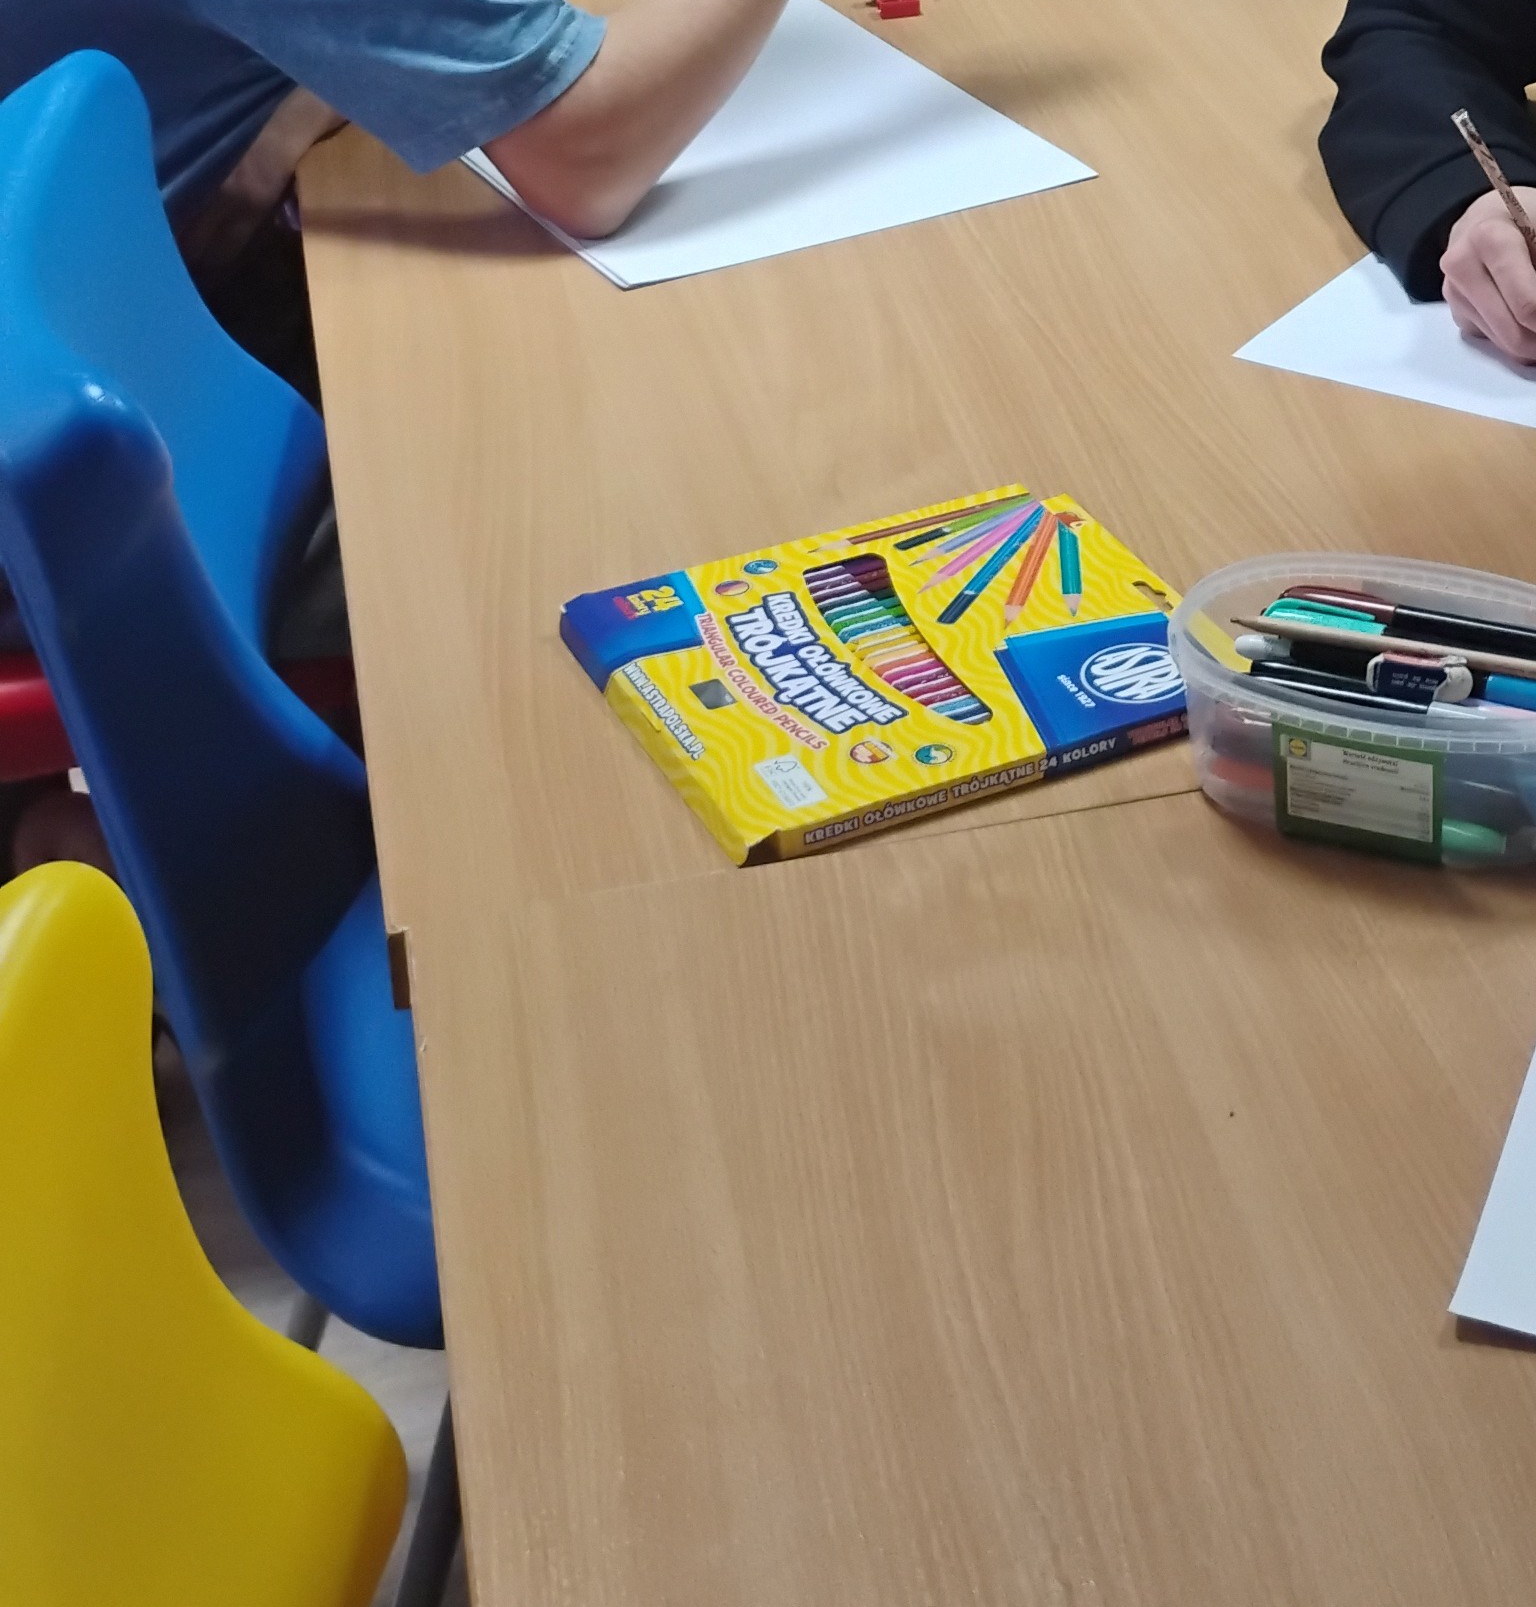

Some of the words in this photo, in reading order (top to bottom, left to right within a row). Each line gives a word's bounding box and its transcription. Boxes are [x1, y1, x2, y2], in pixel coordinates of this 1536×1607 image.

[698, 612, 737, 670] TRIANGULAR
[727, 668, 778, 717] COLOURED
[772, 712, 829, 751] PENCILS
[729, 606, 868, 733] TRÓJKĄTNE
[767, 592, 815, 645] KREDKI
[799, 644, 903, 725] OŁÓWKOWE
[803, 816, 860, 845] KREDKI
[863, 791, 949, 827] OŁÓWKOWE
[952, 763, 1036, 800] TRÓJKĄTNE
[1038, 756, 1058, 773] 24
[1062, 736, 1117, 766] KOLORY
